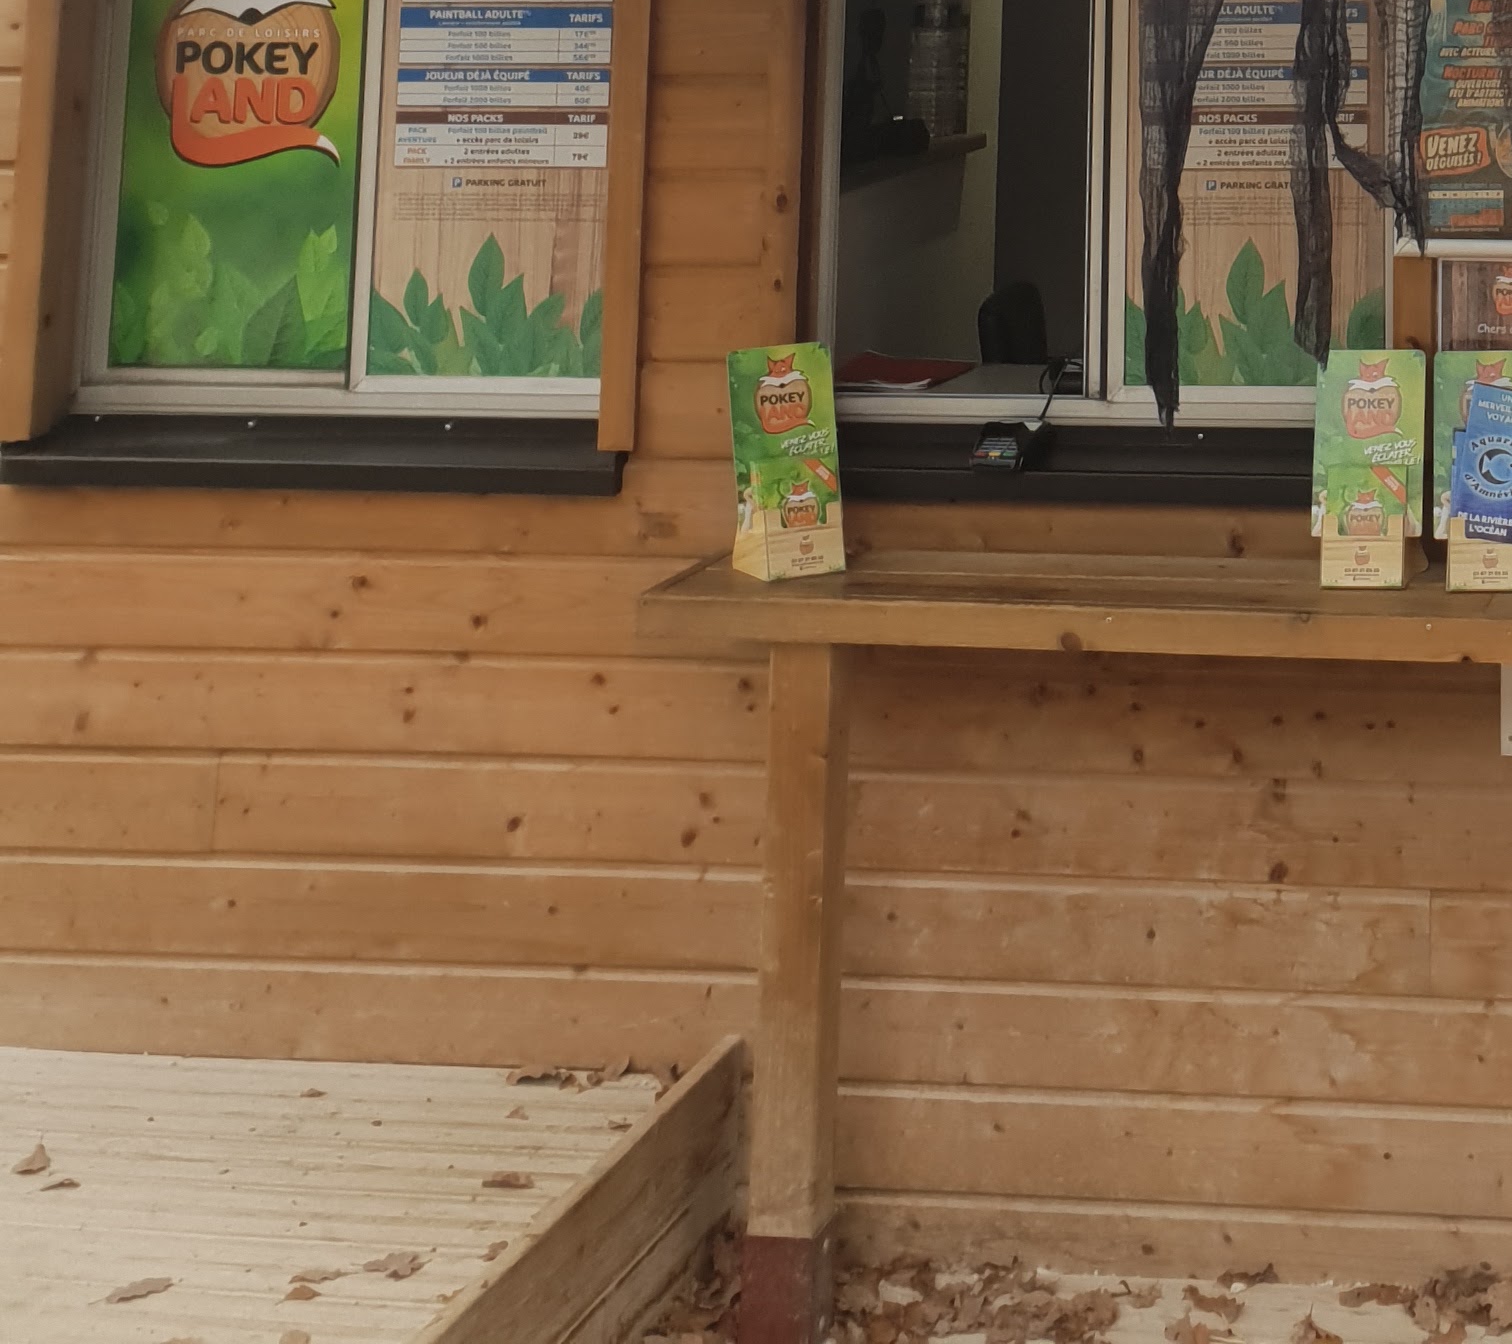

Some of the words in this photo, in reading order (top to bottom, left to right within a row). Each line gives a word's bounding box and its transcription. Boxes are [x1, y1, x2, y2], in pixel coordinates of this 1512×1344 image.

[430, 10, 483, 19] PAINTBALL
[485, 10, 523, 18] ADULTE
[1235, 6, 1275, 14] ADULTE
[570, 14, 602, 22] TARIFS
[178, 27, 216, 38] PARC
[227, 28, 245, 38] DE
[255, 28, 321, 38] LOISIRS
[176, 40, 319, 75] POKEY
[425, 72, 464, 81] JOUEUR
[466, 70, 491, 80] DÉJÀ
[494, 70, 530, 81] ÉQUIPÉ
[567, 72, 600, 80] TARIFS
[1217, 68, 1242, 78] DÉJÀ
[1246, 68, 1283, 79] ÉQUIPÉ
[171, 76, 320, 125] LAND
[448, 114, 468, 122] NOS
[471, 114, 503, 122] PACKS
[1199, 114, 1221, 122] NOS
[1223, 114, 1257, 122] PACKS
[1427, 133, 1478, 158] VENEZ
[1426, 152, 1474, 170] DÉGUISÉS
[1477, 323, 1506, 334] Chers
[760, 392, 805, 406] POKEY
[1347, 398, 1395, 409] POKEY
[1469, 513, 1480, 522] LA
[1469, 525, 1507, 536] L'OCÉAN
